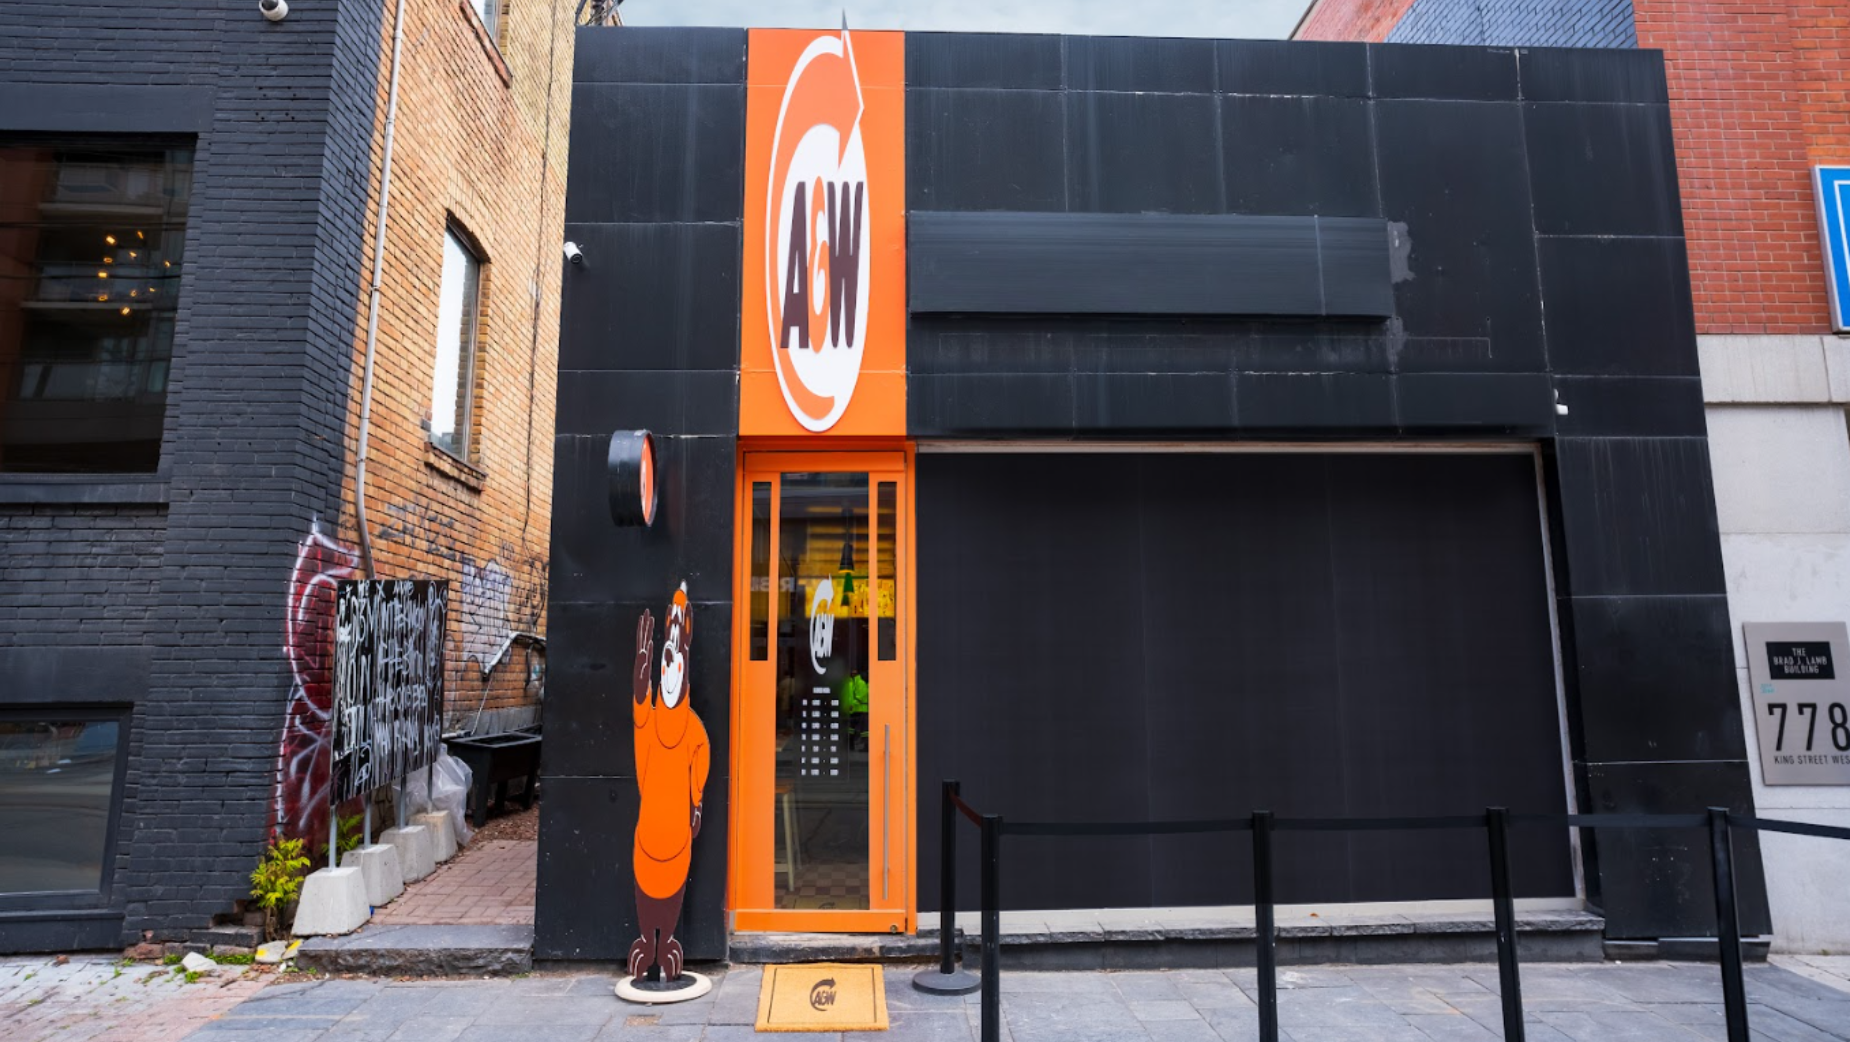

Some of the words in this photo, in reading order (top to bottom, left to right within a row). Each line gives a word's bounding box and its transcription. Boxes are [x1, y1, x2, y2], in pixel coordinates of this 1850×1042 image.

[780, 176, 864, 354] A&W
[1791, 647, 1807, 656] THE
[1773, 656, 1794, 665] BRAD
[1805, 656, 1828, 665] LAMB
[1784, 665, 1820, 674] BUILDING
[1767, 702, 1850, 752] 778
[1773, 755, 1795, 765] KING
[1797, 755, 1829, 765] STREET
[813, 989, 837, 1006] A&W
